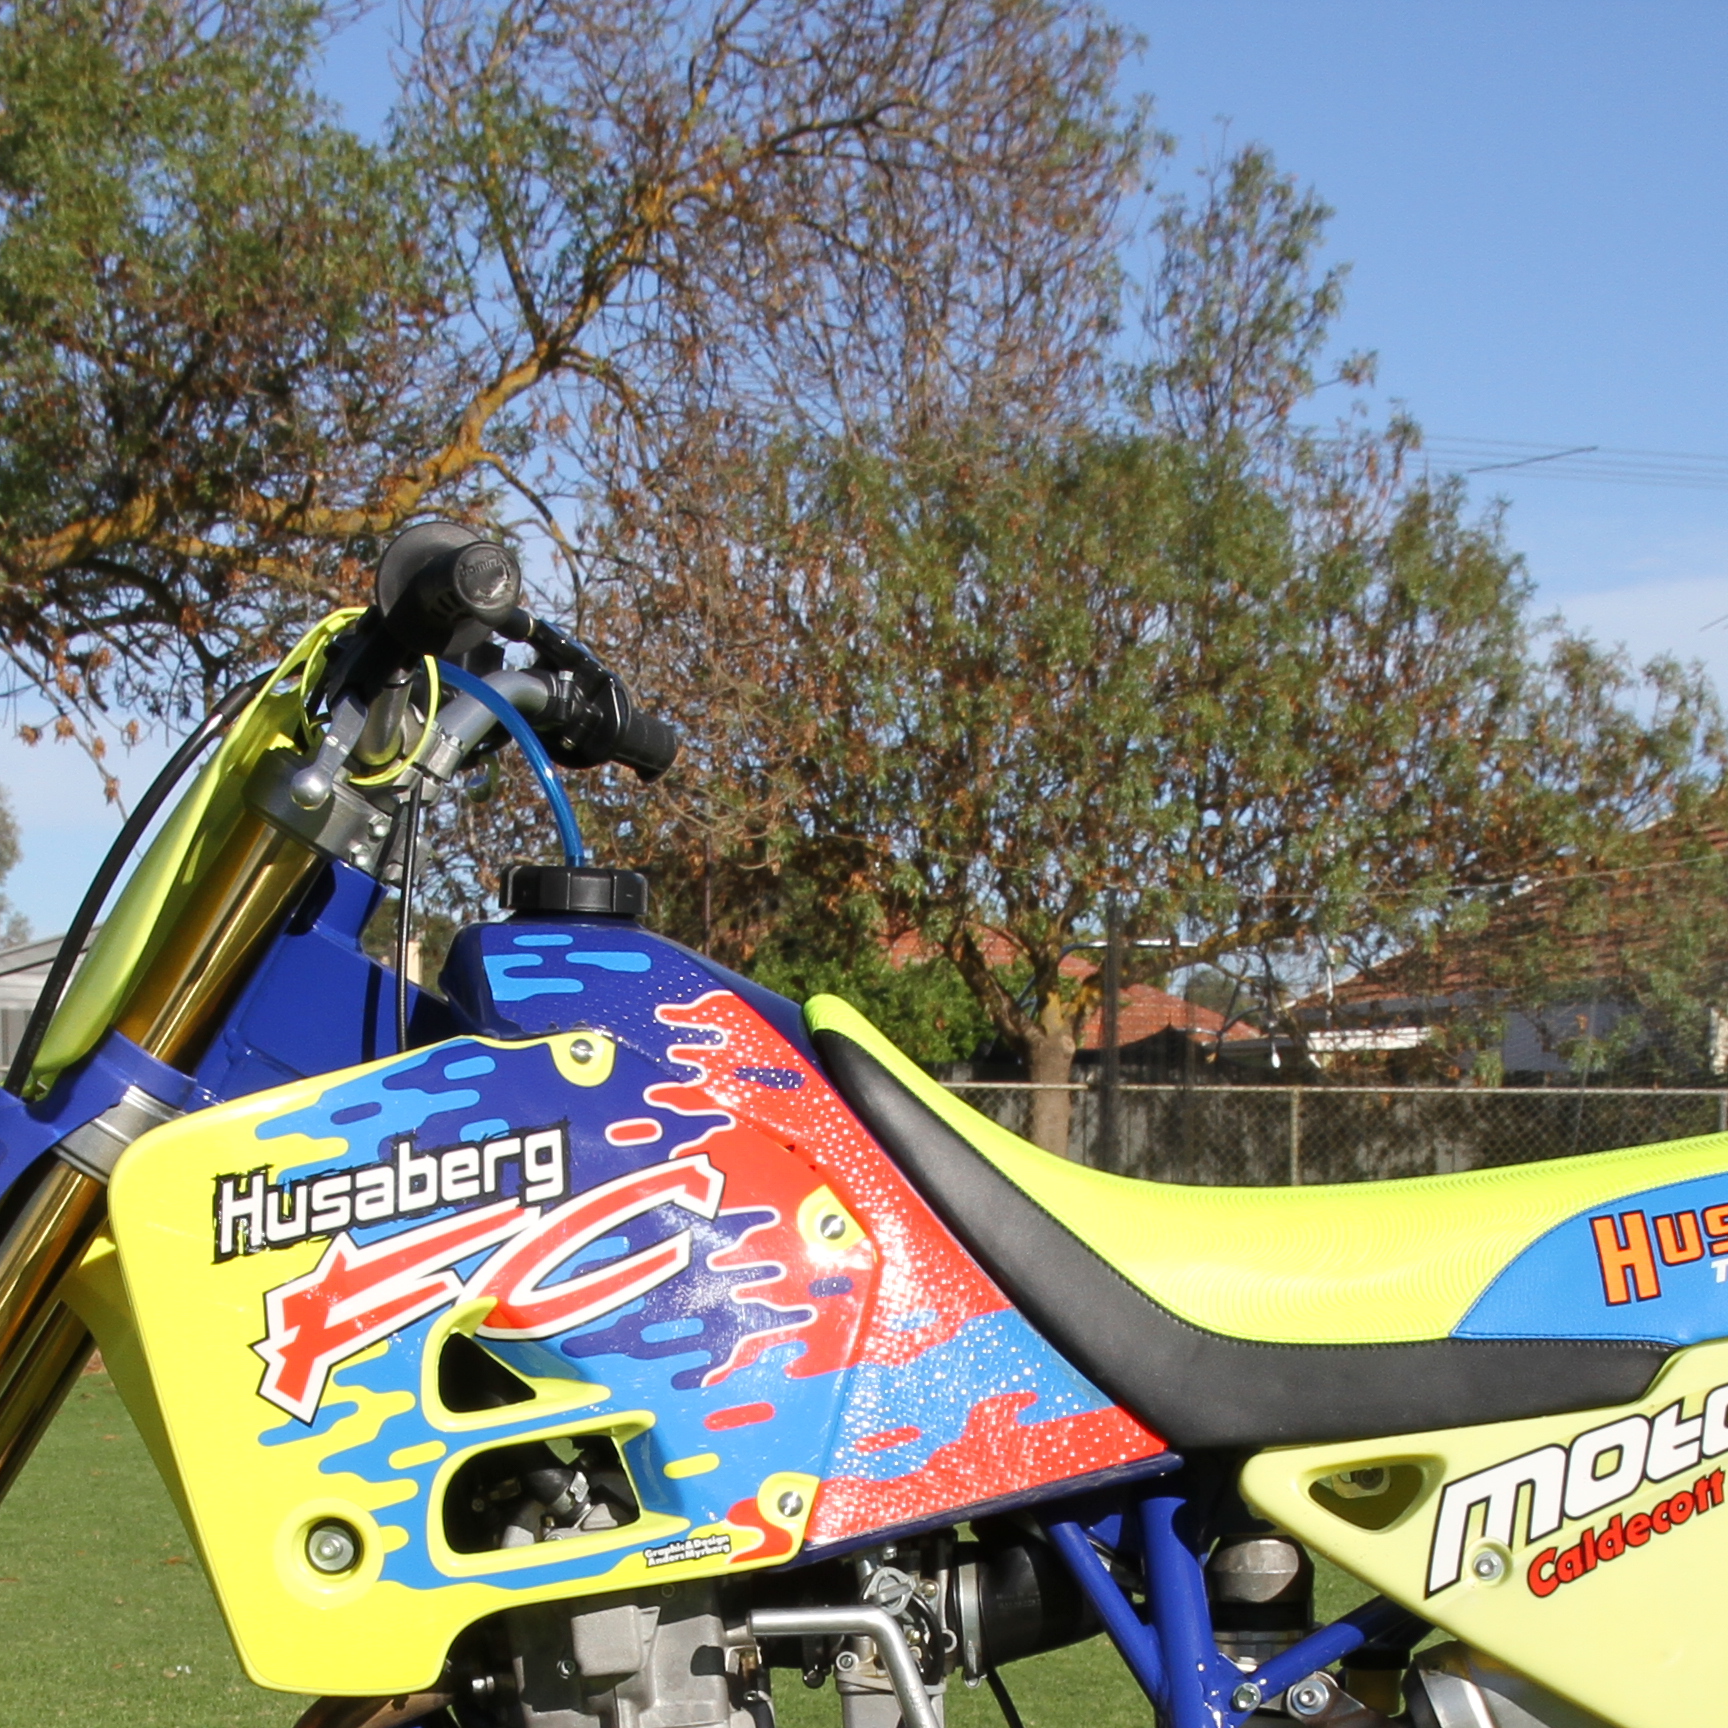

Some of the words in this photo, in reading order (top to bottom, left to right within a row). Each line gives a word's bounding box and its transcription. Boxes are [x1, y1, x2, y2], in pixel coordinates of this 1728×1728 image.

[215, 1128, 566, 1257] Husaberg
[248, 1153, 725, 1424] FC
[1526, 1468, 1726, 1600] Caldecott
